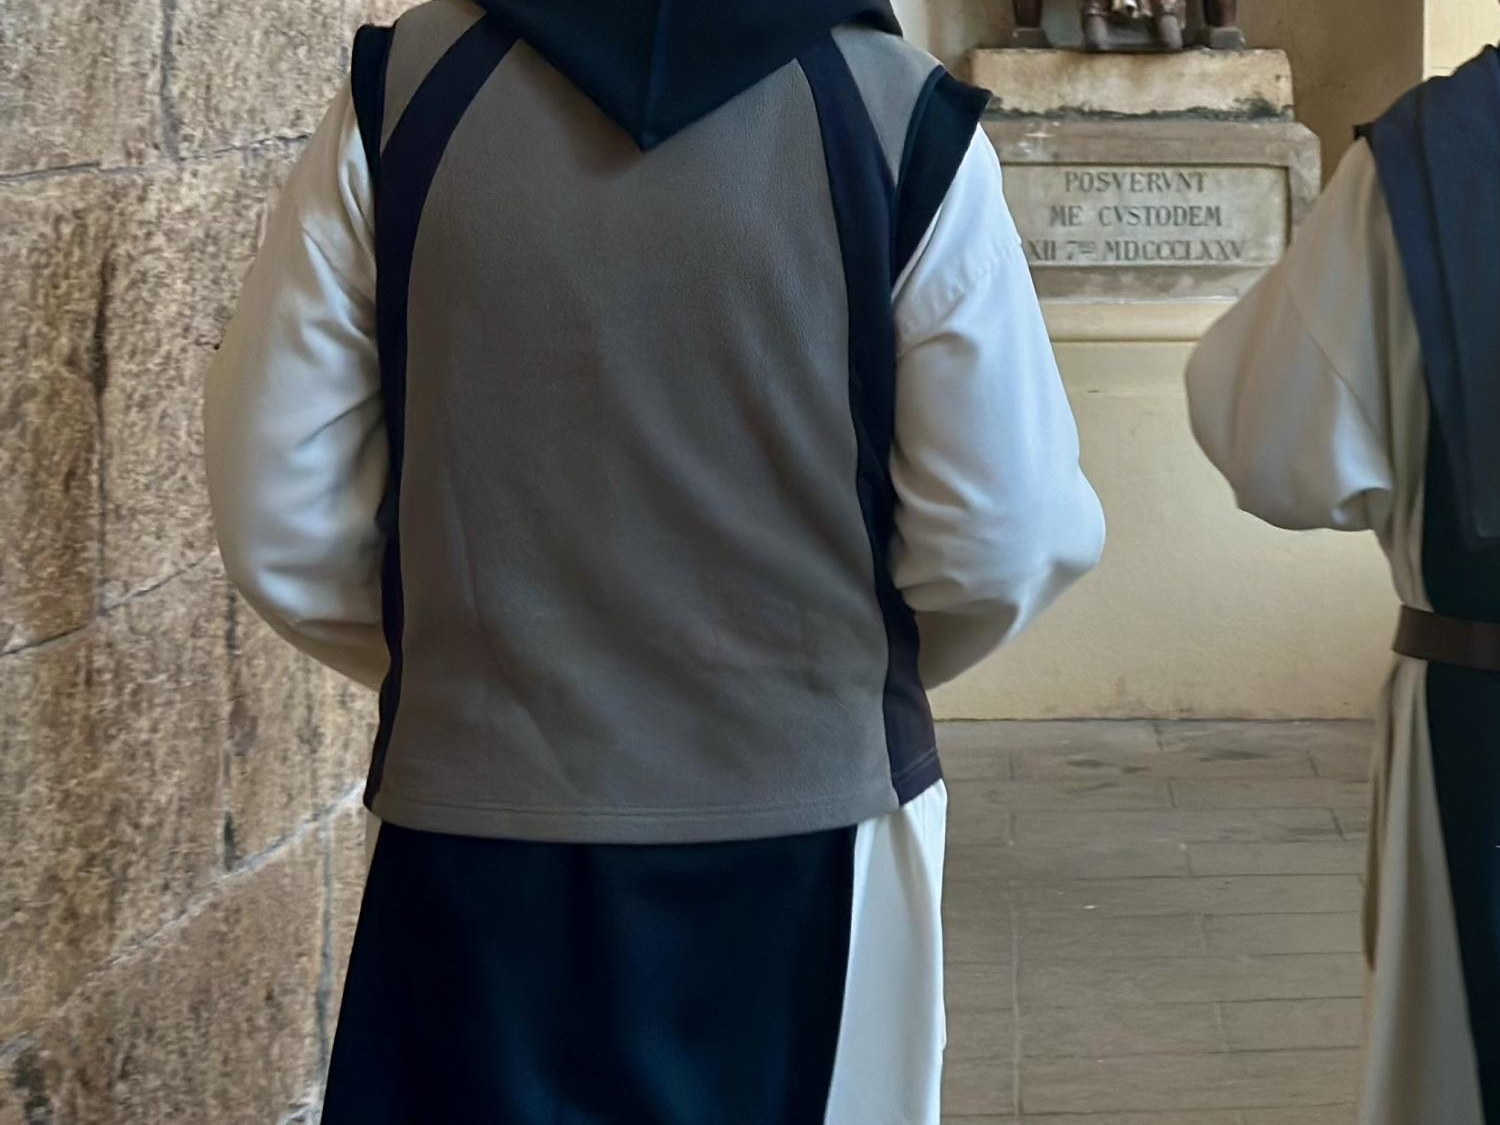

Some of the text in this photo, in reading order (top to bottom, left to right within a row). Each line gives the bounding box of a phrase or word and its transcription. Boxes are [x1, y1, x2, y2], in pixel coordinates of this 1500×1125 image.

[1065, 171, 1208, 193] POSVERVNT
[1050, 204, 1222, 226] ME CVSTODEM
